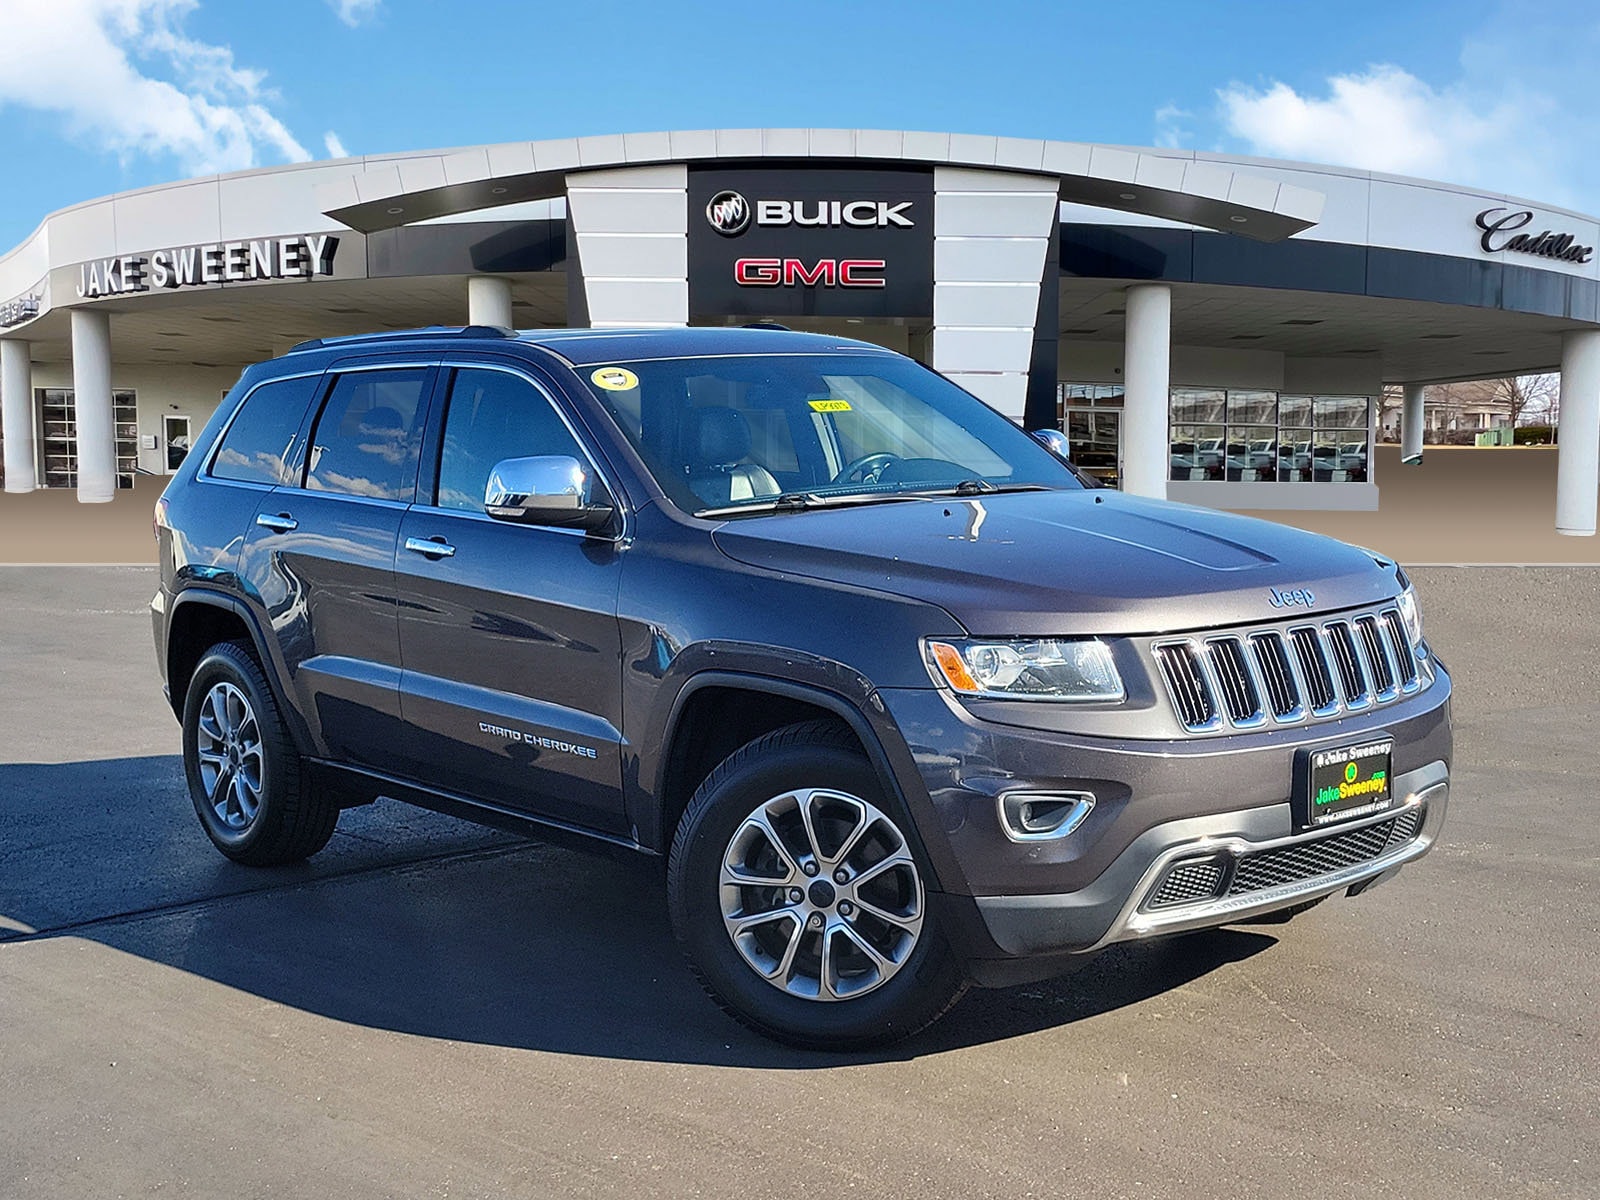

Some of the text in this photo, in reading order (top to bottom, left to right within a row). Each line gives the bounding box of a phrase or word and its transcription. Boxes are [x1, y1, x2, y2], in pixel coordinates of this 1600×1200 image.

[757, 200, 915, 227] BUICK
[1475, 207, 1593, 264] Cadillac
[76, 235, 335, 298] JAKE SWEENEY
[734, 258, 886, 286] GMC
[1268, 586, 1316, 609] Jeep
[479, 721, 597, 759] GRAND CHEROKEE
[1349, 742, 1392, 760] Sweeney
